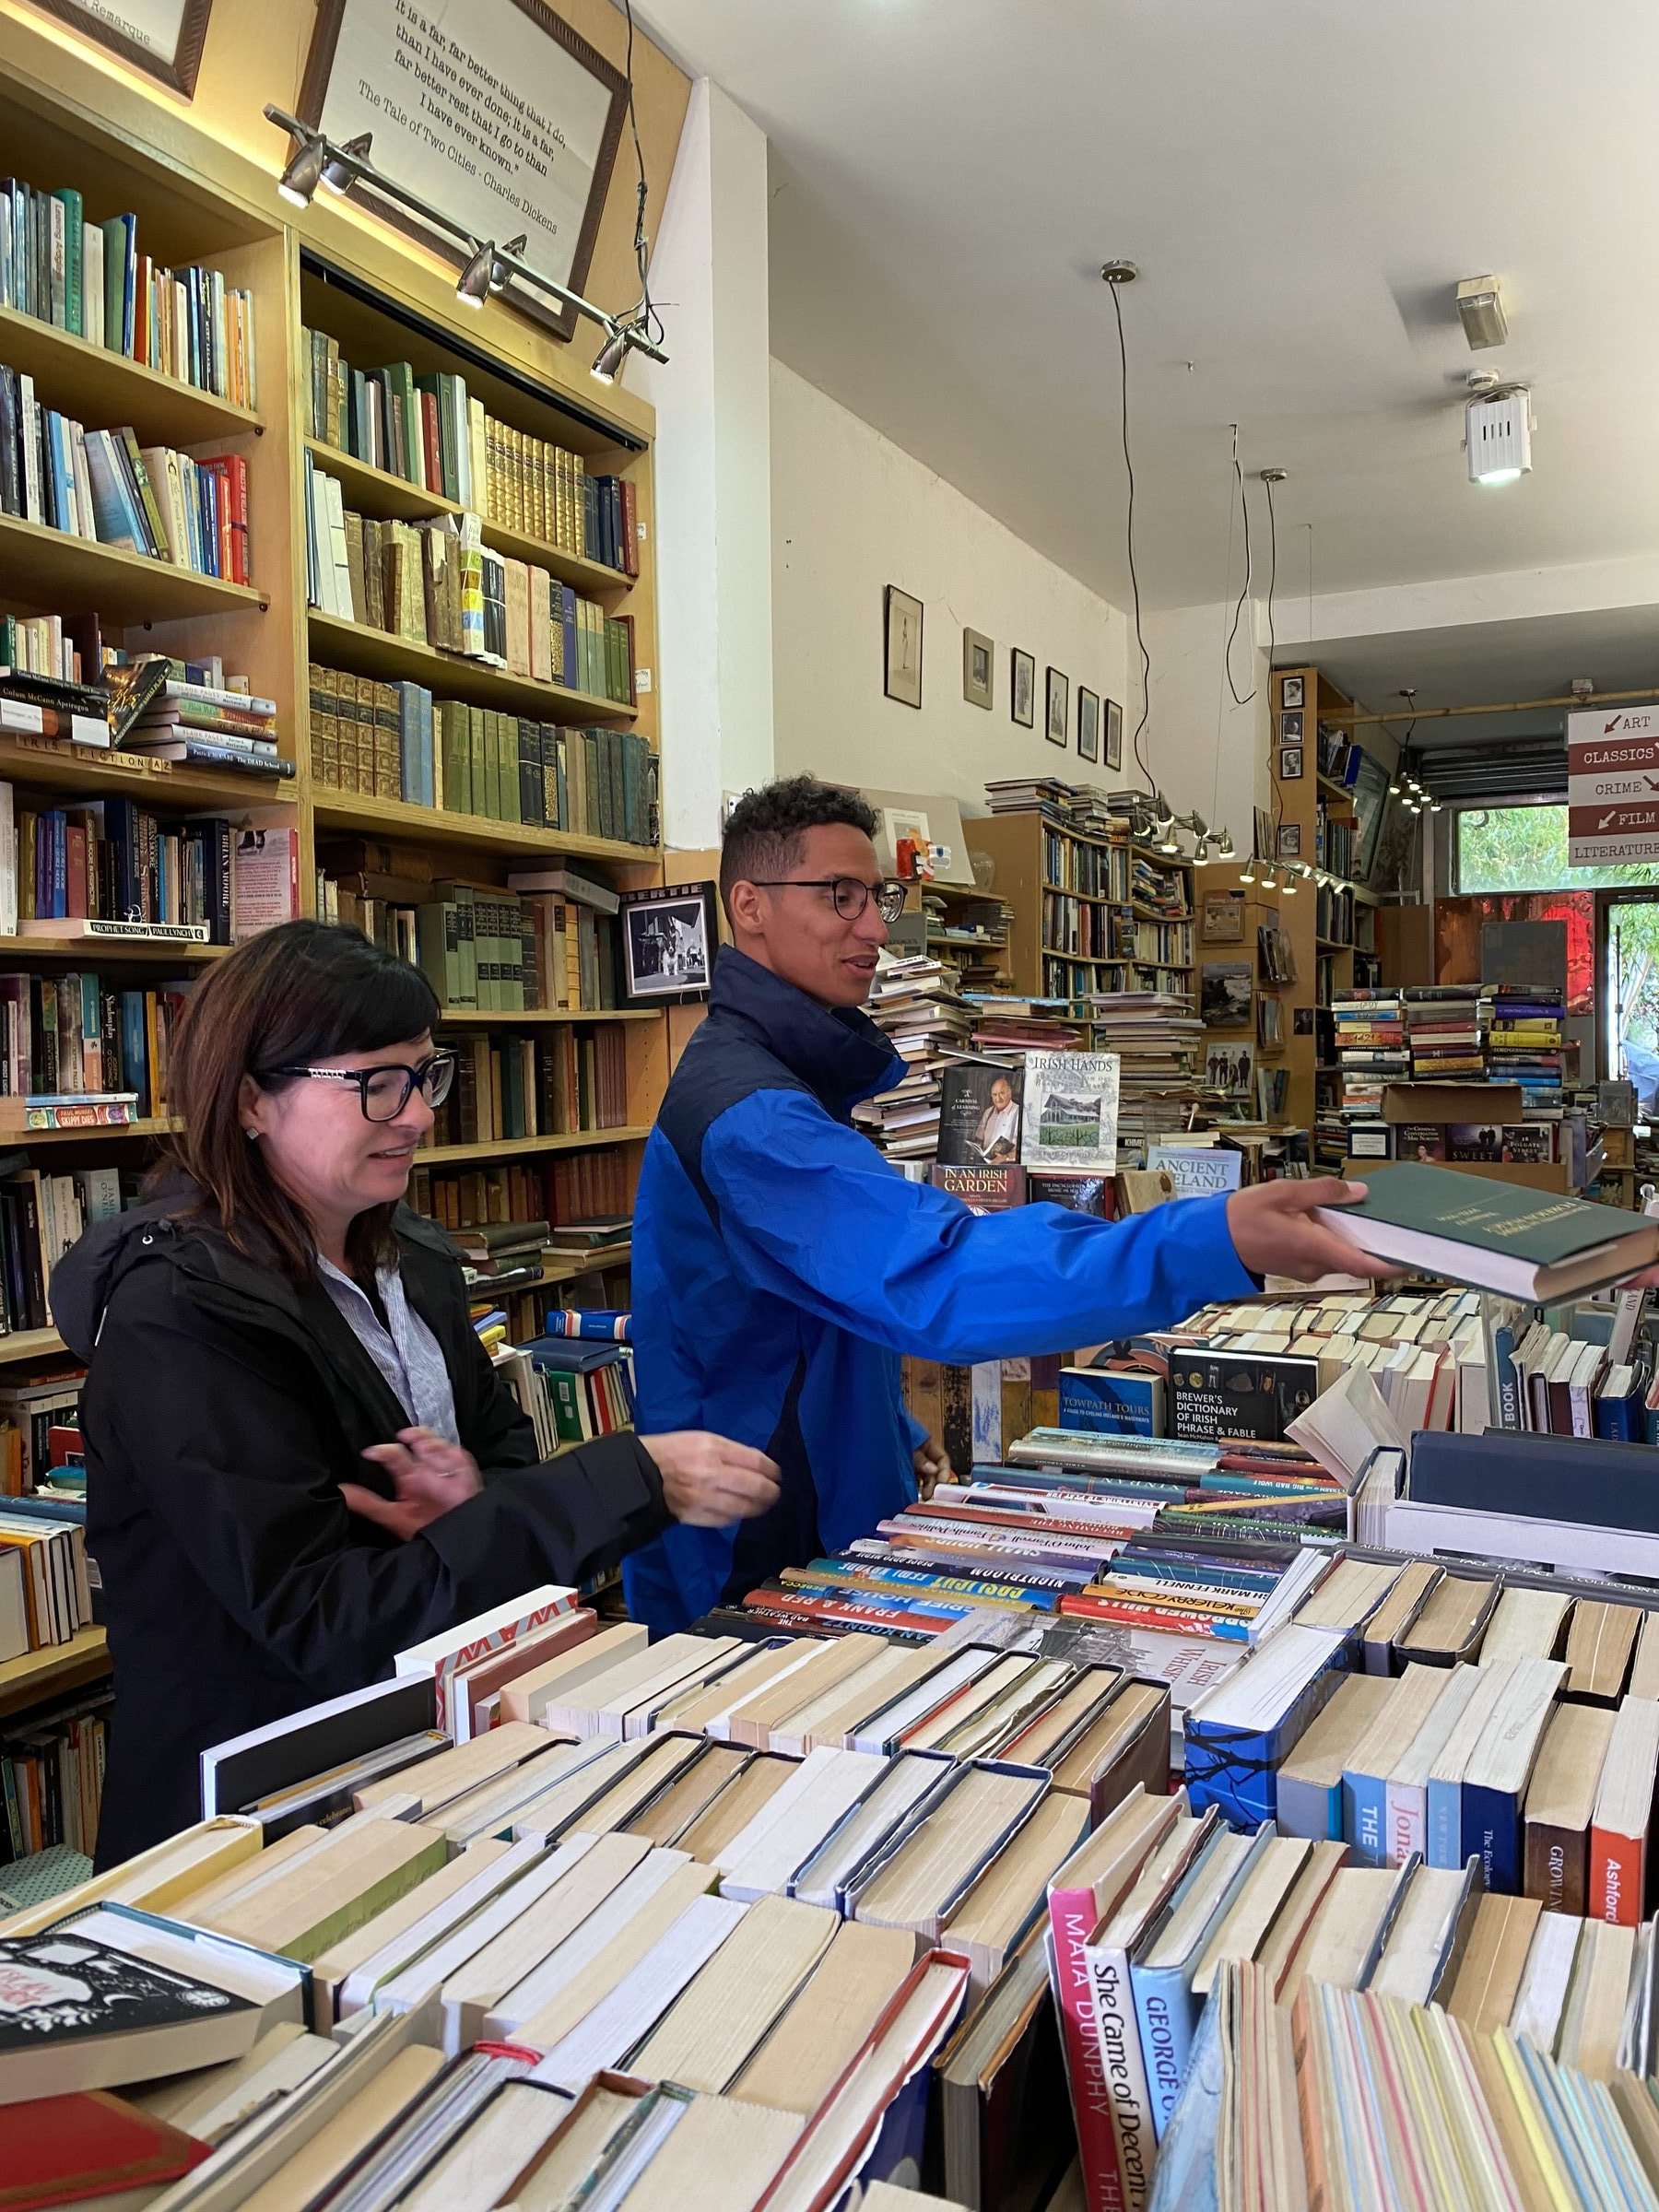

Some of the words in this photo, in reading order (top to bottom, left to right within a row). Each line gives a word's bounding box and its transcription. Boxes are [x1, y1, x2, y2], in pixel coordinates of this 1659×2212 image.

[91, 0, 150, 44] Remarque
[407, 7, 418, 24] is
[419, 18, 427, 33] a
[429, 24, 446, 53] far,
[449, 41, 466, 63] far
[467, 54, 500, 89] better
[500, 83, 524, 114] thing
[526, 104, 546, 128] that
[546, 120, 553, 135] I
[553, 127, 566, 149] do,
[395, 23, 422, 54] than
[424, 45, 430, 60] I
[431, 52, 457, 82] have
[458, 76, 484, 101] ever
[484, 94, 512, 127] done;
[513, 115, 522, 134] it
[523, 124, 531, 141] is
[533, 133, 538, 147] a
[539, 139, 555, 162] far,
[394, 49, 413, 71] far
[414, 62, 447, 98] better
[449, 92, 470, 117] rest
[471, 107, 493, 136] that
[493, 125, 500, 141] I
[500, 134, 513, 151] go
[513, 143, 524, 159] to
[524, 148, 547, 177] than
[419, 92, 427, 107] I
[427, 99, 453, 127] have
[454, 124, 478, 147] ever
[359, 78, 381, 107] The
[382, 97, 407, 126] Tale
[408, 120, 423, 135] of
[422, 125, 446, 153] Two
[447, 145, 477, 176] Cities
[483, 171, 521, 208] Charles
[521, 199, 558, 235] Dickens
[3, 688, 27, 700] Colum
[28, 693, 54, 705] McCann
[56, 699, 89, 712] Apeirogon
[1622, 715, 1651, 730] ART
[80, 748, 145, 767] FICTION
[1583, 747, 1654, 764] CLASSICS
[1595, 781, 1642, 795] CRIME
[1618, 811, 1655, 826] FILM
[221, 834, 229, 865] BRIAN
[1574, 842, 1659, 859] LITERATURE
[221, 869, 229, 908] MOORE
[621, 883, 703, 902] BERTIE
[91, 922, 120, 935] PROPHET
[120, 924, 146, 936] SONG
[151, 926, 171, 937] PAUL
[170, 927, 193, 938] LYNCH
[104, 994, 116, 1039] Shadowplay
[1034, 1057, 1069, 1070] IRISH
[1070, 1058, 1112, 1073] HANDS
[61, 1115, 82, 1125] SKIPPY
[82, 1114, 94, 1124] DIES
[1453, 1151, 1494, 1160] SWEET
[945, 1169, 957, 1179] IN
[960, 1170, 975, 1180] AN
[979, 1170, 1008, 1180] IRISH
[1156, 1159, 1229, 1176] ANCIENT
[945, 1179, 1008, 1193] GARDEN
[1174, 1173, 1228, 1189] ELAND
[1063, 1396, 1112, 1411] TOWPATH
[1114, 1402, 1150, 1416] TOURS
[1176, 1391, 1223, 1405] BREWER'S
[1502, 1382, 1515, 1422] BOOK
[1176, 1402, 1239, 1417] DICTIONARY
[1177, 1413, 1191, 1423] OF
[1192, 1414, 1218, 1425] IRISH
[1177, 1422, 1216, 1436] PHRASE
[1217, 1427, 1225, 1436] &
[1228, 1428, 1256, 1439] FABLE
[1100, 1497, 1156, 1509] EVERYTHING
[908, 1522, 948, 1534] Politics
[948, 1525, 988, 1539] Family
[924, 1535, 982, 1549] HOURS
[1011, 1535, 1063, 1548] O'Farrell
[1064, 1542, 1095, 1552] John
[984, 1544, 1042, 1558] SMALL
[838, 1562, 888, 1579] KAYODE
[906, 1558, 935, 1568] PEACE
[891, 1569, 928, 1582] FEMI
[969, 1566, 1066, 1588] NIGHTBLOOM
[780, 1580, 827, 1592] REBECCA
[929, 1576, 1027, 1600] GASLIGHT
[1113, 1588, 1168, 1601] CODE
[1155, 1579, 1210, 1593] FENNELL
[1211, 1587, 1251, 1599] MARK
[780, 1592, 818, 1606] RED
[822, 1599, 838, 1609] &
[838, 1586, 914, 1605] HOUSE
[1167, 1596, 1236, 1611] KELLERBY
[747, 1608, 787, 1620] WEATHER
[835, 1602, 901, 1619] FRANK
[916, 1598, 976, 1613] GRIEF
[1234, 1607, 1251, 1617] The
[777, 1618, 793, 1627] THE
[789, 1614, 809, 1623] BAD
[821, 1618, 896, 1635] KOONTZ
[900, 1624, 936, 1643] EAN
[1160, 1648, 1206, 1683] WHISK
[1187, 1660, 1228, 1687] IRISH
[1362, 1806, 1378, 1848] THE
[1483, 1830, 1494, 1849] The
[1605, 1858, 1622, 1924] Ashford
[1065, 1913, 1089, 1988] MAIA
[1094, 1963, 1120, 2009] She
[1101, 2012, 1128, 2079] Came
[1146, 1996, 1180, 2090] GEORGE
[1076, 2000, 1110, 2115] DUNPHY
[1112, 2082, 1141, 2110] of
